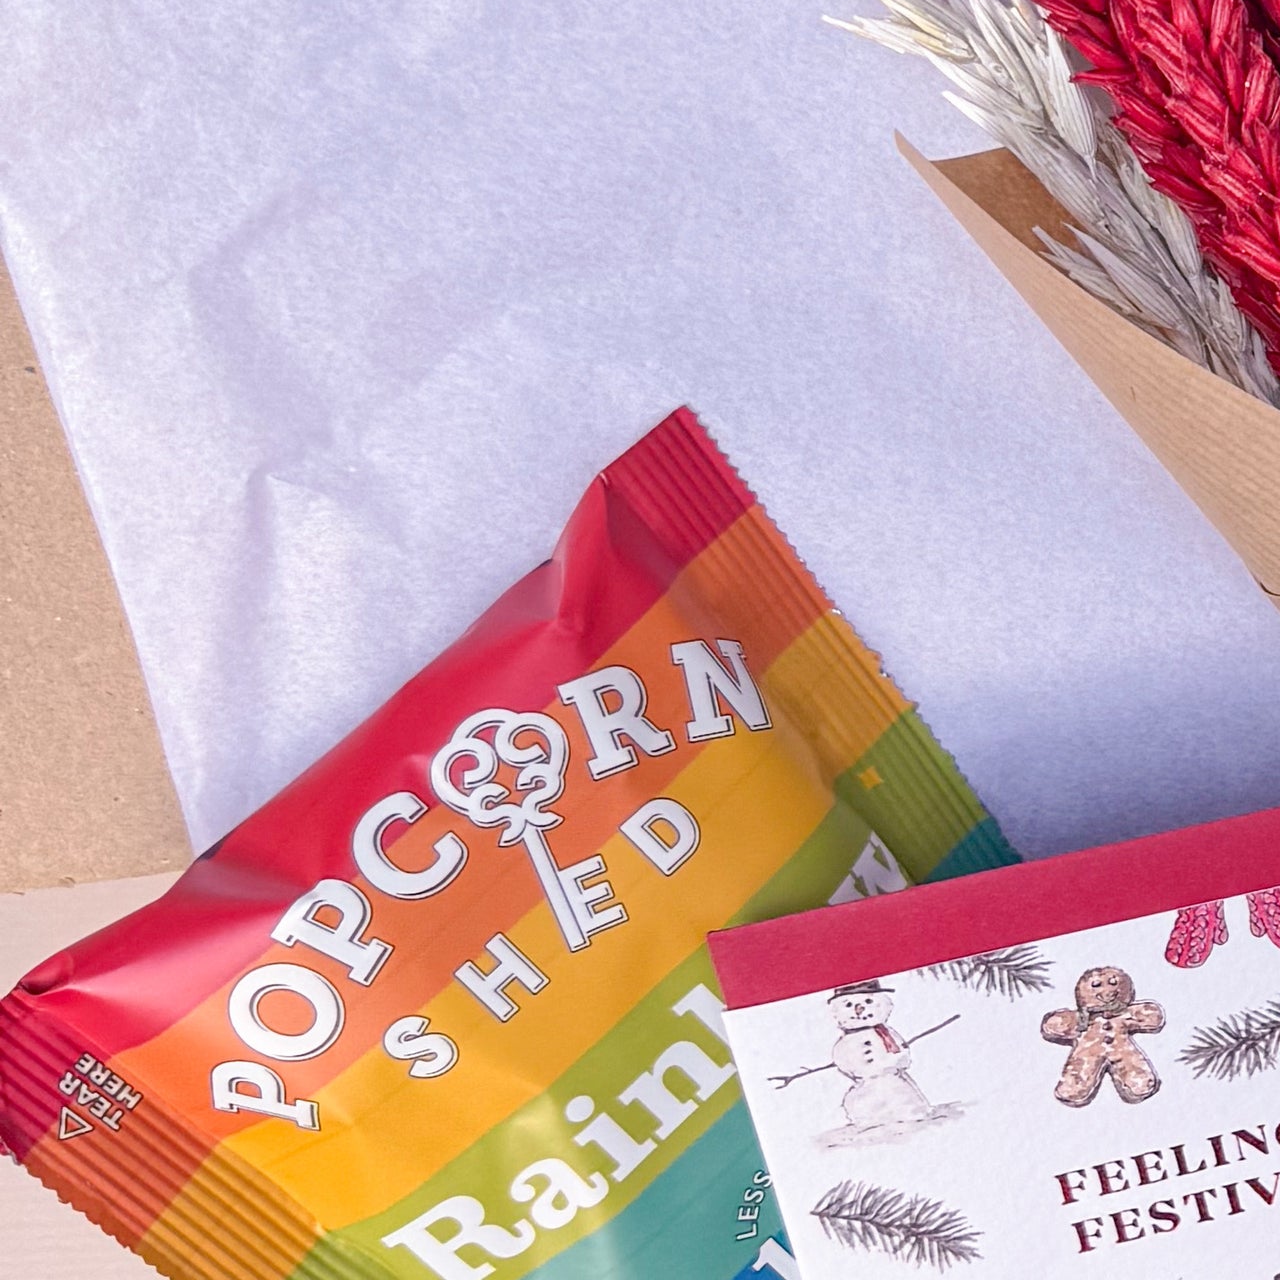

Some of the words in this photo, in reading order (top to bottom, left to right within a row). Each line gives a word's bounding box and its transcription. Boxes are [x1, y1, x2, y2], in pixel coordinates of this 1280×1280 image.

[382, 797, 702, 1079] SHED
[59, 1071, 124, 1131] TEAR
[74, 1051, 143, 1111] HERE
[735, 1169, 773, 1242] LESS
